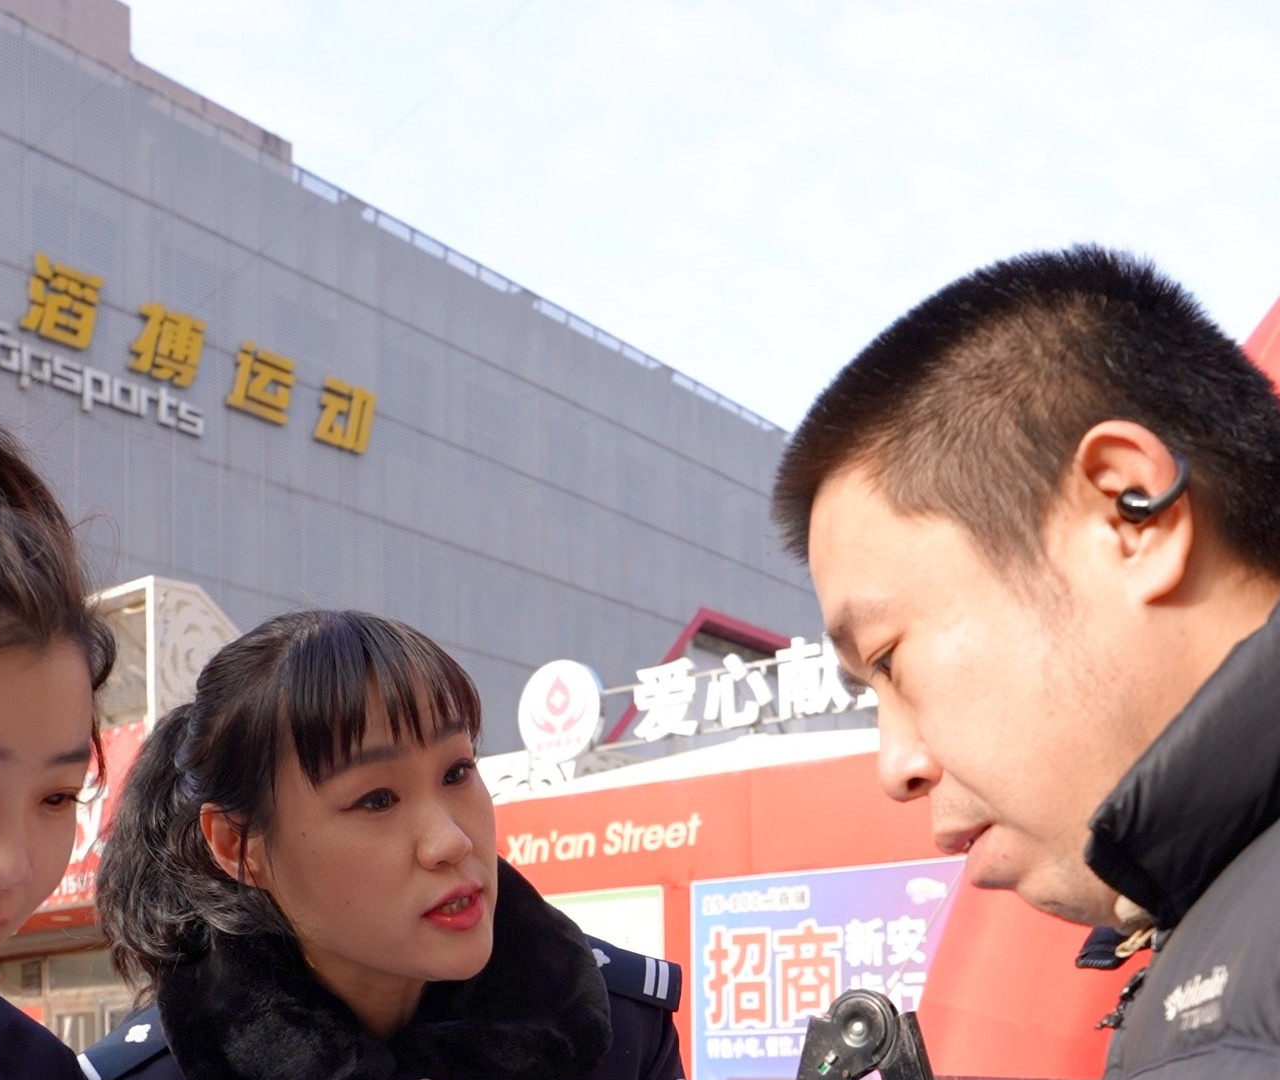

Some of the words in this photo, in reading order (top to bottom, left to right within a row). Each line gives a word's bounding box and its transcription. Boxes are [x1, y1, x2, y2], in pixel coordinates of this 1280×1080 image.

[633, 631, 879, 743] 爱心献
[506, 829, 597, 866] Xin'an
[604, 812, 703, 855] Street
[705, 919, 843, 1028] 招商
[845, 916, 927, 966] 新安
